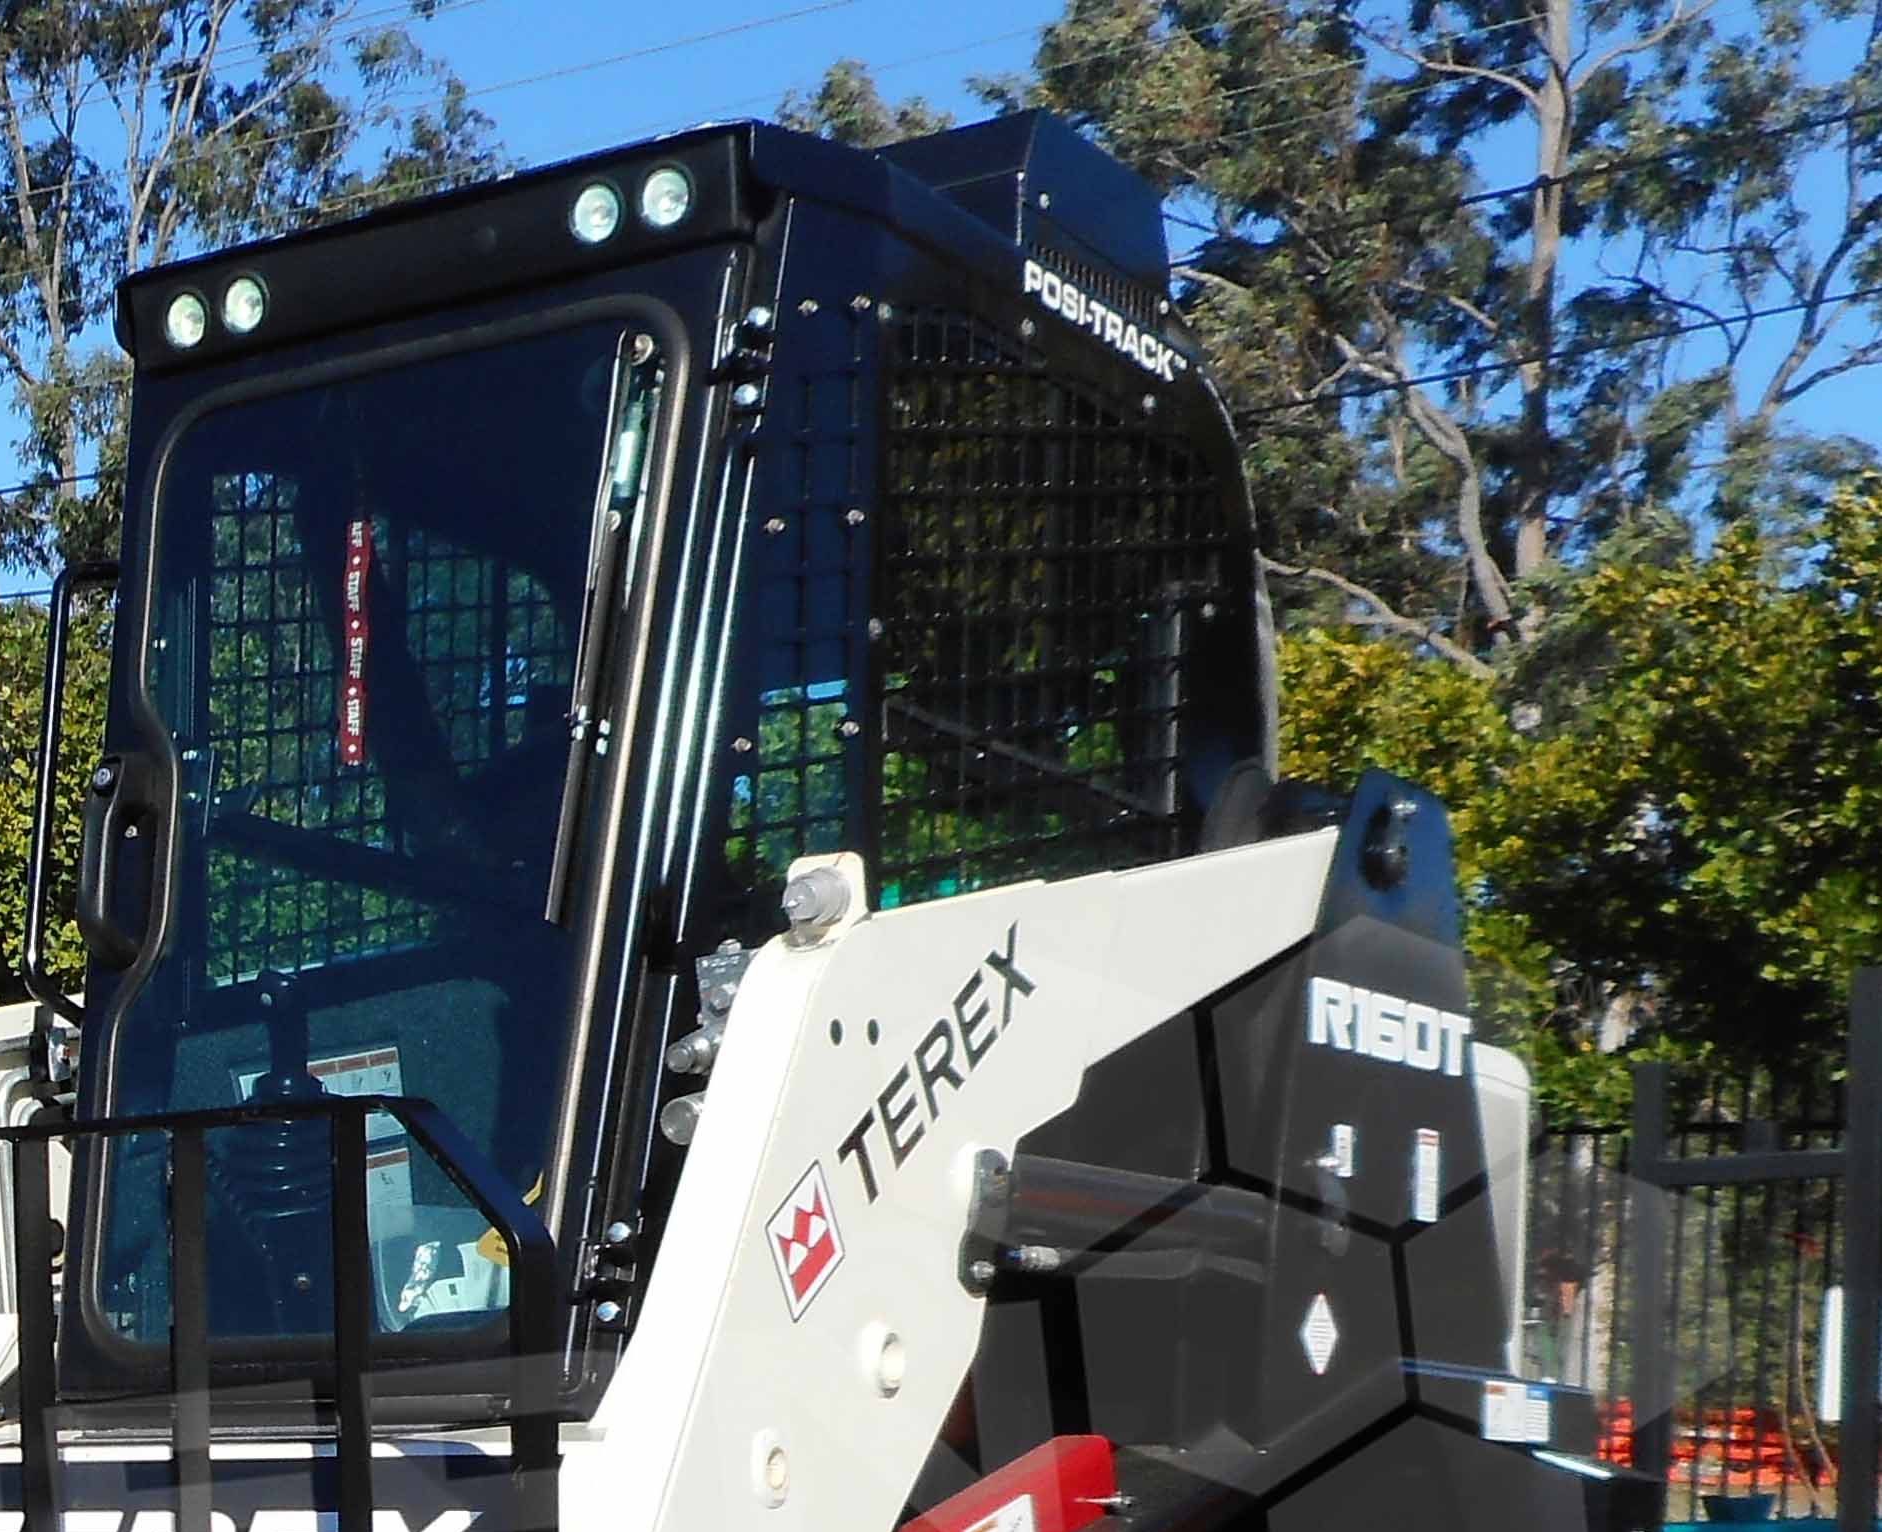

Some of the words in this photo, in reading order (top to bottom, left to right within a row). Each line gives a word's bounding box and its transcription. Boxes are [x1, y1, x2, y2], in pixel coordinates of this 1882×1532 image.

[347, 570, 360, 612] STAFF
[349, 636, 363, 679] STAFF
[347, 699, 360, 736] STAFF
[1309, 976, 1472, 1077] R160T
[836, 919, 1037, 1204] TEREX
